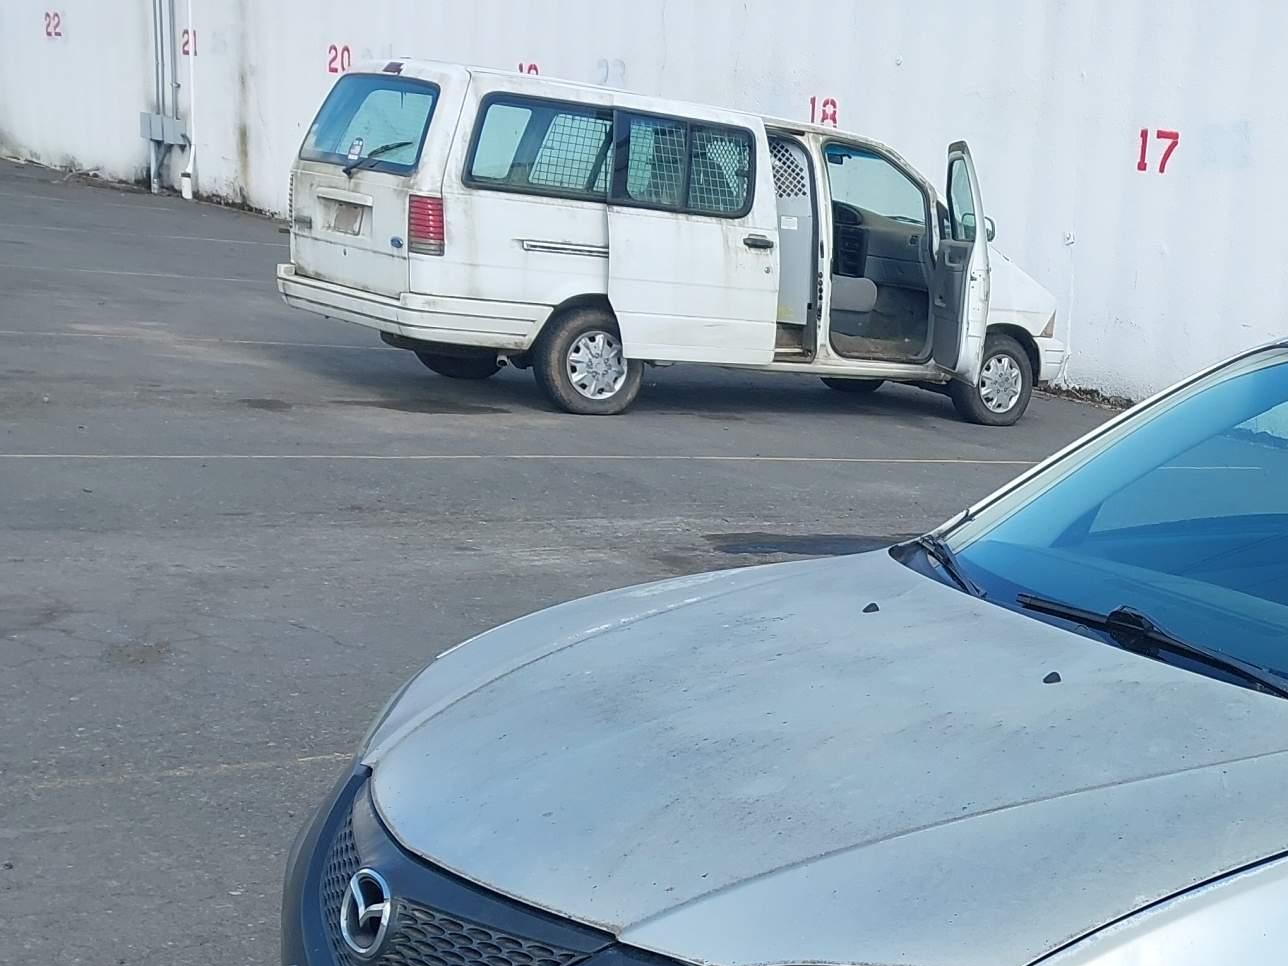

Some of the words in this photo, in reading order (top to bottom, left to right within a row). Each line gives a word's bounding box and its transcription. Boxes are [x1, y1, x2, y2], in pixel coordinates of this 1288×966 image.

[44, 12, 62, 37] 22
[182, 29, 198, 57] 21
[328, 44, 351, 73] 20
[809, 95, 838, 128] 18
[1136, 128, 1180, 174] 17
